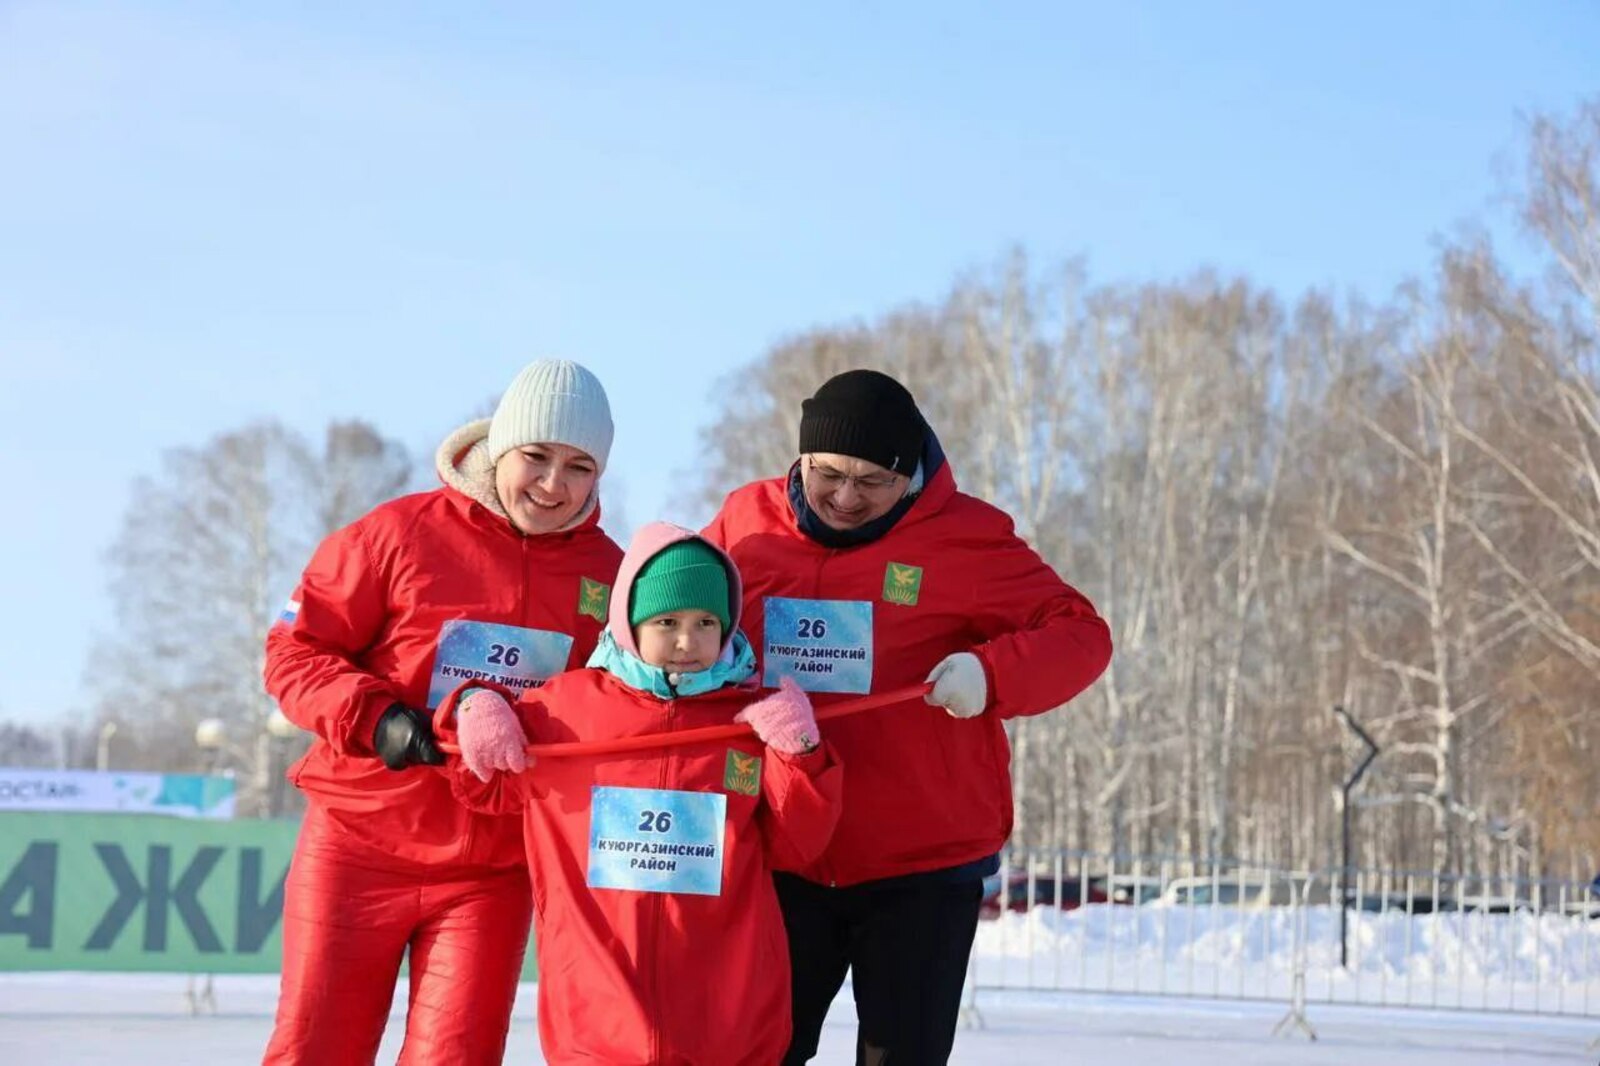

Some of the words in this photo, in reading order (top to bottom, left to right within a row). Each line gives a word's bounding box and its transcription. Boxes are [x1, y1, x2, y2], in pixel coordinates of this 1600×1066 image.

[798, 618, 826, 639] 26
[487, 643, 520, 667] 26
[769, 645, 866, 660] КУЮРГАЗИНСКИЙ
[794, 660, 833, 673] РАЙОН
[442, 665, 546, 689] КУЮРГАЗИНСКИ
[638, 810, 673, 833] 26
[598, 840, 716, 858] КУЮРГАЗИНСКИЙ
[630, 857, 676, 871] РАЙОН
